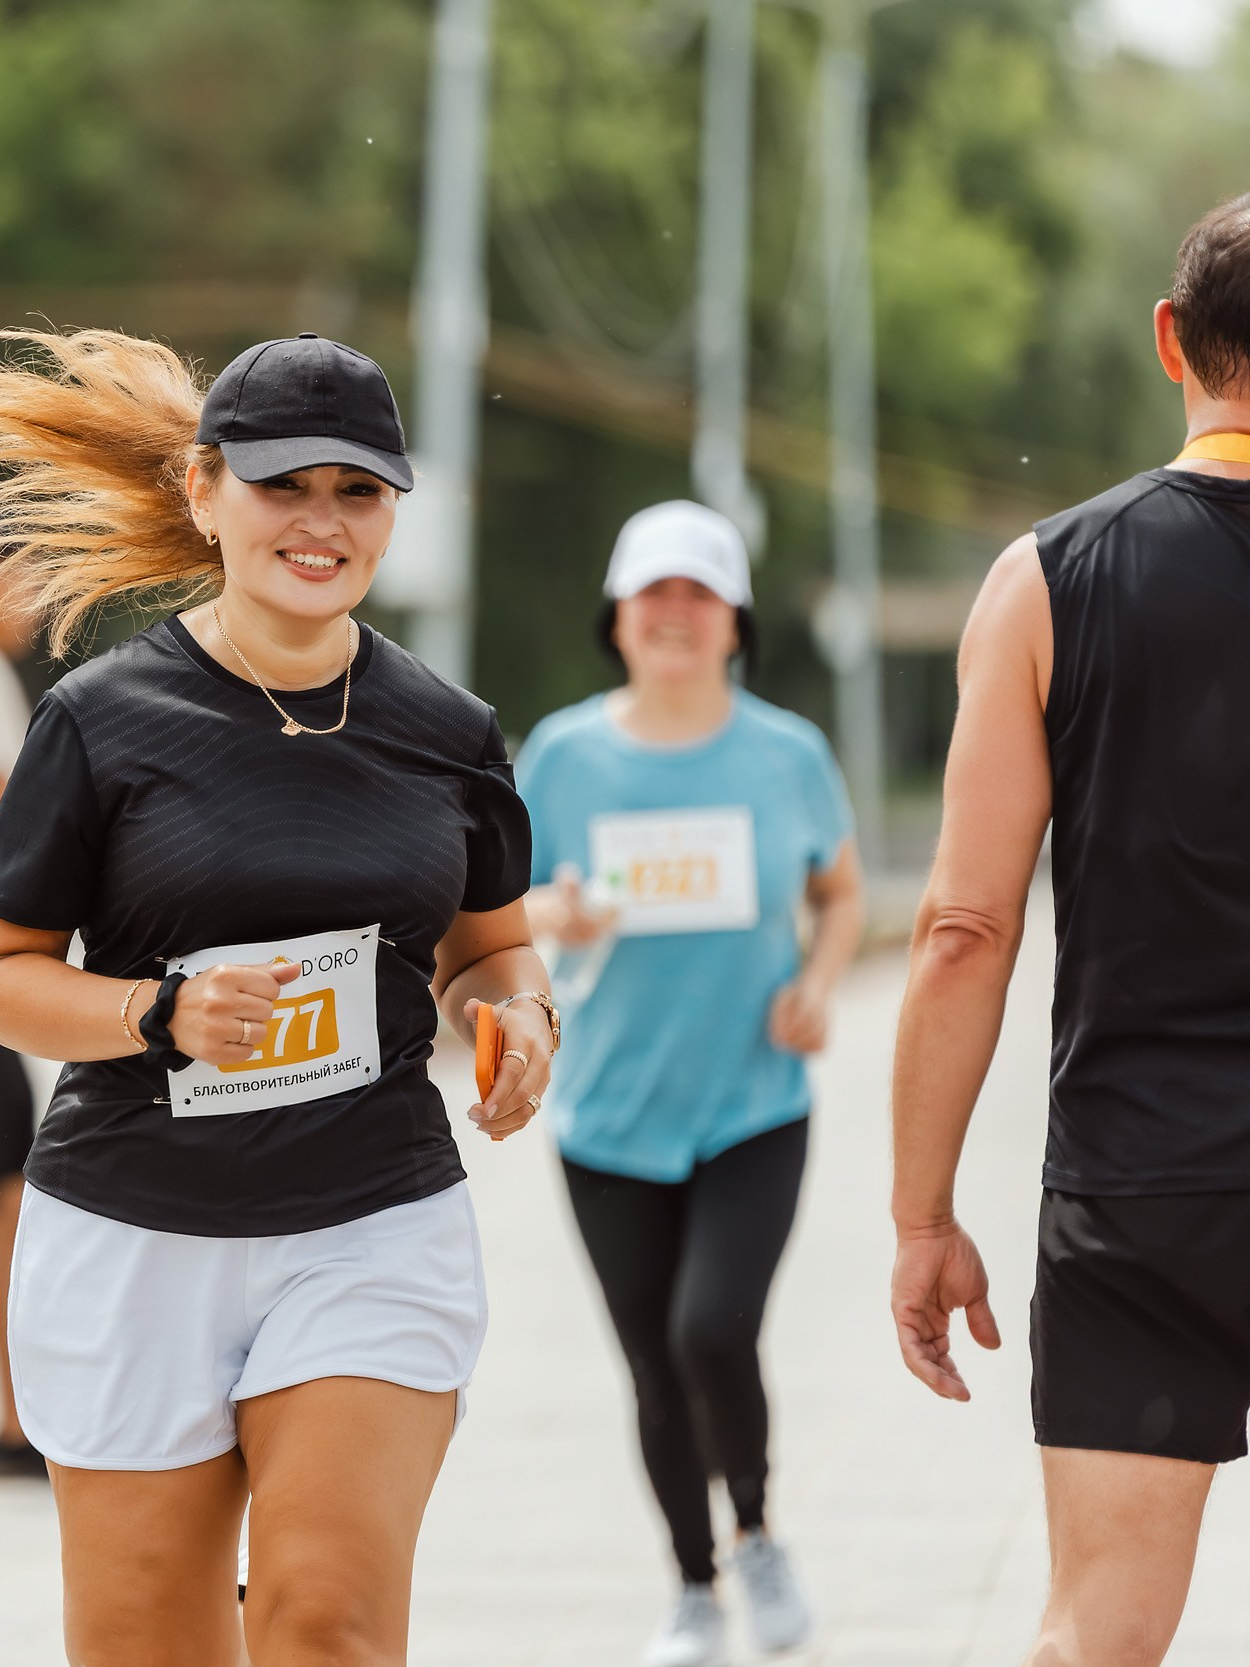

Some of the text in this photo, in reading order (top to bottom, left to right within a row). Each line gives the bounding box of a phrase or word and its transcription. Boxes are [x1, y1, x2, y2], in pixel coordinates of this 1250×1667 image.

[302, 948, 358, 977] D'ORO
[246, 999, 324, 1061] 77
[193, 1056, 362, 1097] БЛАГОТВОРИТЕЛЬНЫЙ ЗАБЕГ
